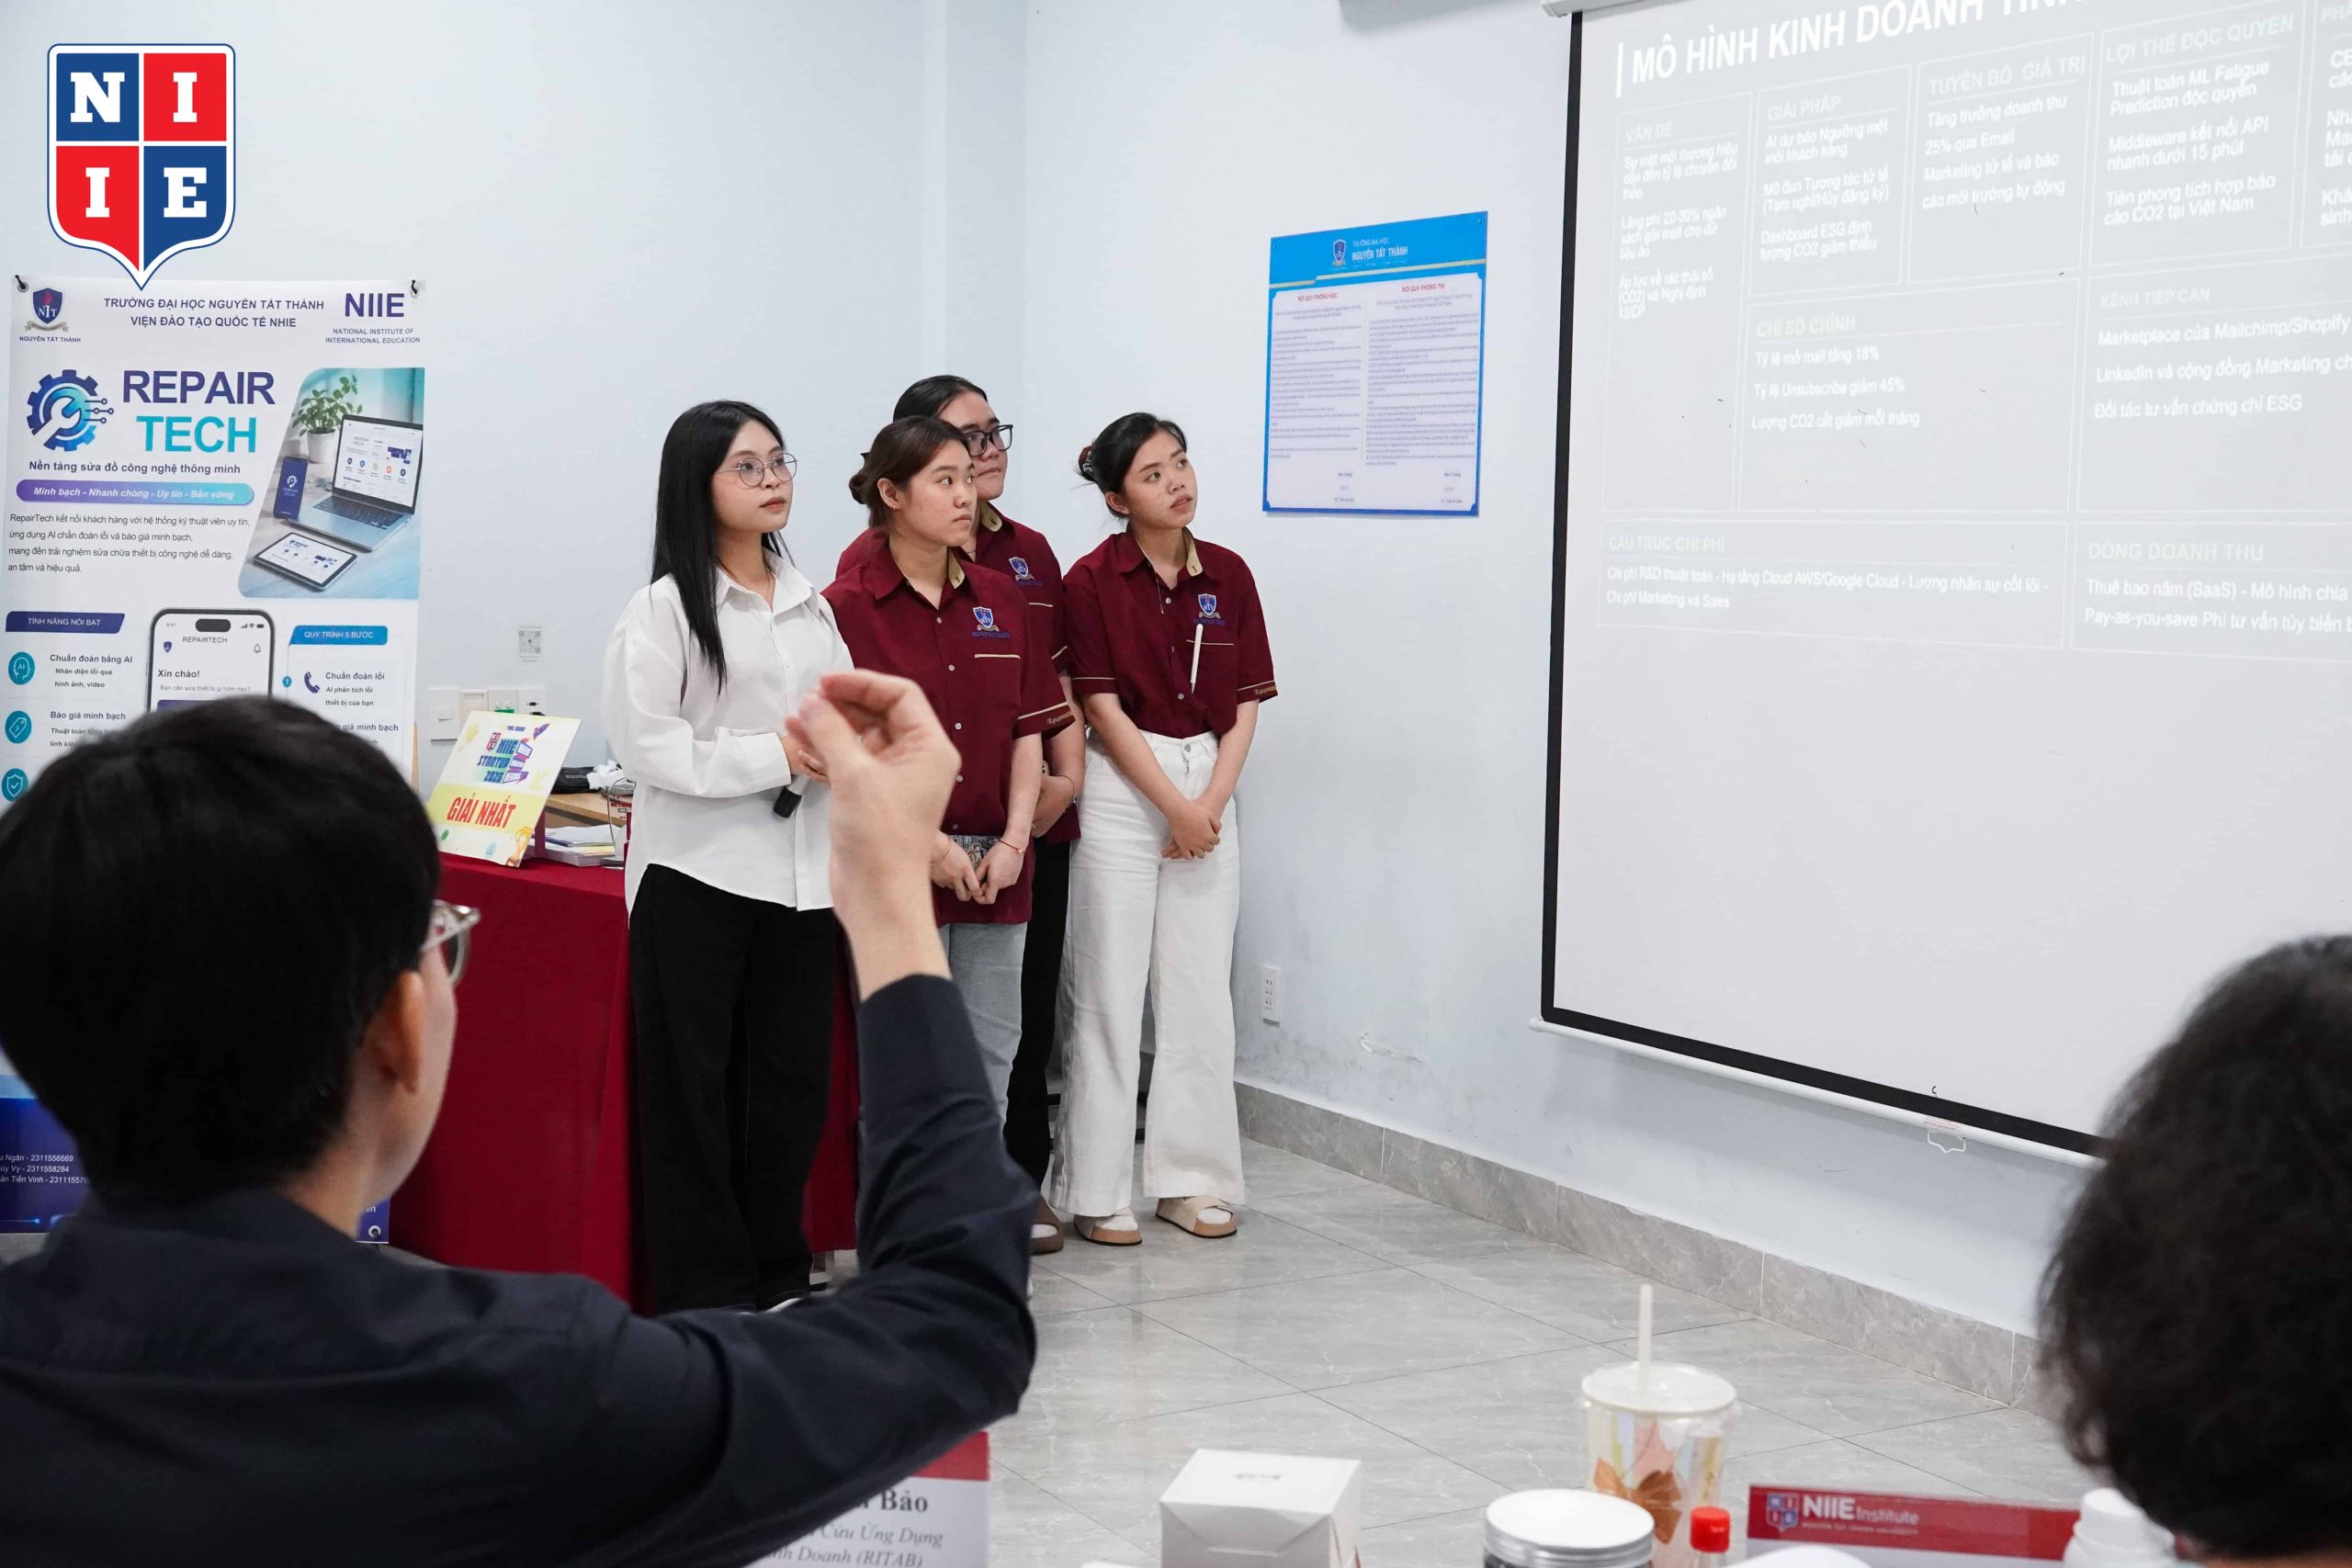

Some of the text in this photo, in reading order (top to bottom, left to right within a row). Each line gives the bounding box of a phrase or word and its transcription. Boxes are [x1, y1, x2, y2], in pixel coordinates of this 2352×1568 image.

[1632, 0, 1984, 84] MÔ HÌNH KINH DOANH
[2188, 69, 2211, 86] ML
[2215, 62, 2270, 82] Fatigue
[2004, 96, 2043, 117] doanh
[2046, 95, 2067, 110] thu
[2110, 94, 2178, 117] Prediction
[1926, 129, 2015, 154] 25% qua Email
[104, 298, 154, 309] TRƯỜNG
[158, 299, 177, 310] ĐẠI
[181, 299, 205, 310] HỌC
[209, 298, 256, 310] NGUYỄN
[286, 298, 324, 310] THÀNH
[345, 293, 405, 317] NIIE
[130, 315, 157, 328] VIỆN
[160, 314, 185, 326] ĐÀO
[188, 317, 212, 329] TẠO
[252, 315, 266, 327] TẾ
[269, 318, 297, 327] NHIE
[2098, 313, 2351, 347] Marketplace của Mailchimp/Shopify
[2096, 364, 2153, 383] LinkedIn
[2157, 363, 2174, 379] và
[2177, 362, 2212, 381] cộng
[2256, 355, 2331, 375] Marketing
[123, 370, 276, 404] REPAIR
[2120, 401, 2141, 417] tác
[2145, 401, 2159, 416] tư
[2163, 396, 2188, 416] vấn
[2192, 398, 2237, 417] chứng
[2267, 394, 2302, 412] ESG
[136, 415, 256, 453] TECH
[29, 459, 241, 475] Nền tảng sửa đồ công nghệ thông minh
[34, 487, 56, 495] Minh
[59, 488, 80, 497] bạch
[88, 489, 119, 497] Nhanh
[157, 490, 169, 499] Uy
[10, 514, 54, 523] RepairTech
[56, 514, 67, 523] kết
[70, 513, 81, 523] nối
[108, 515, 128, 525] hàng
[155, 515, 176, 525] thống
[188, 517, 209, 525] thuật
[209, 517, 225, 525] viên
[227, 519, 236, 527] uy
[9, 530, 25, 539] ứng
[26, 531, 46, 540] dụng
[138, 533, 150, 542] giá
[2086, 578, 2348, 602] Thuê bao năm (SaaS) Mô hình chia
[2086, 607, 2199, 628] Pay-as-you-save
[182, 636, 228, 644] REPAIRTECH
[50, 653, 76, 662] Chuẩn
[79, 655, 99, 663] đoán
[157, 670, 199, 678] Xin chào!
[69, 711, 82, 720] giá
[106, 713, 126, 721] bạch
[447, 793, 517, 829] GIẢI NHẤT
[11, 1165, 21, 1173] Vy
[880, 1488, 928, 1513] Bảo
[1802, 1495, 1920, 1526] NIIE Institute
[861, 1522, 894, 1546] Ứng
[899, 1527, 944, 1550] Dụng
[797, 1546, 851, 1563] Doanh
[857, 1550, 923, 1568] (RITAB)
